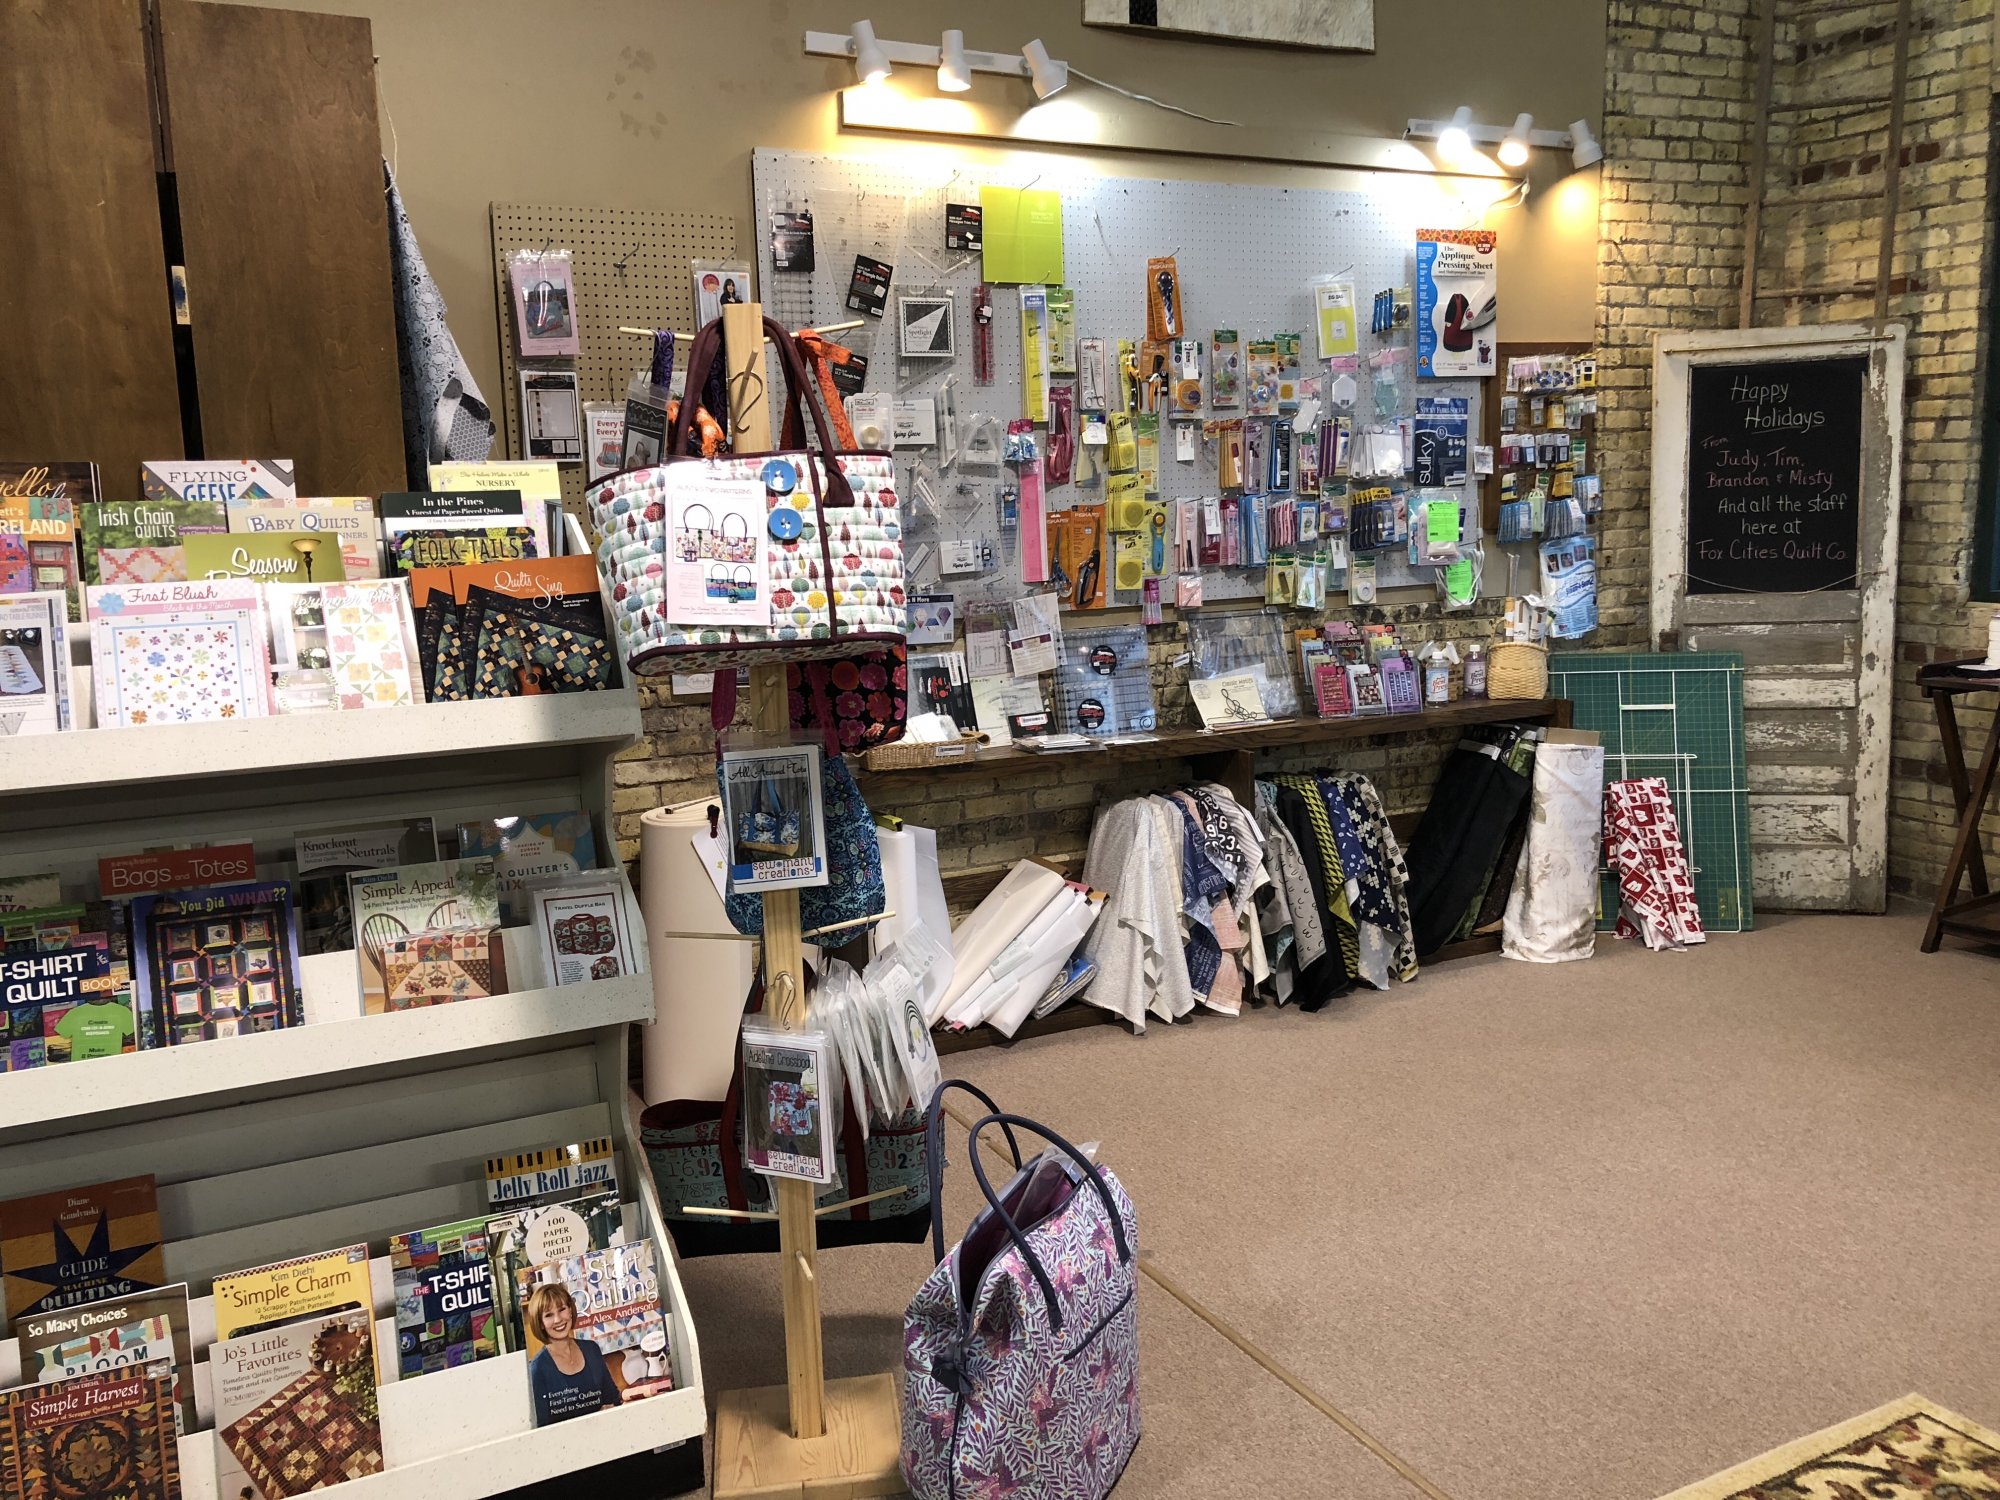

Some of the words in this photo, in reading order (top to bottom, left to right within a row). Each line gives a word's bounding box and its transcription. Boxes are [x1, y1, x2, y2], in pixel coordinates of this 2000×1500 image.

[1440, 252, 1475, 260] Applique
[1438, 261, 1470, 270] Pressing
[1473, 262, 1493, 270] Sheet
[1731, 375, 1789, 405] Happy
[1744, 406, 1825, 434] Holidays
[1700, 435, 1728, 449] From
[168, 471, 247, 483] FLYING
[1706, 472, 1769, 488] Brandon
[1790, 470, 1833, 493] Misty
[183, 483, 236, 501] GEESE
[423, 498, 434, 507] In
[456, 497, 484, 505] Pines
[1719, 498, 1746, 514] And
[1750, 498, 1770, 512] all
[1776, 495, 1801, 512] the
[1808, 494, 1848, 512] staff
[0, 507, 24, 516] ett's
[98, 507, 128, 527] Irish
[134, 507, 175, 525] Chain
[0, 519, 66, 535] RELAND
[135, 525, 176, 538] QUILTS
[250, 517, 295, 532] BABY
[302, 514, 359, 531] QUILTS
[1741, 518, 1778, 535] here
[1783, 519, 1802, 535] at
[418, 538, 520, 561] FOLK-TAILS
[1696, 539, 1722, 560] Fox
[1730, 539, 1778, 560] Cities
[1784, 540, 1822, 560] Quilt
[1826, 543, 1846, 560] Co
[231, 547, 298, 576] Season
[128, 588, 169, 603] First
[173, 586, 217, 600] Blush
[494, 571, 532, 592] Quilts
[533, 575, 566, 609] Sing
[209, 601, 234, 609] Month
[728, 765, 750, 781] All
[751, 763, 785, 778] Around
[303, 838, 358, 852] Knockout
[346, 844, 396, 859] Neutrals
[112, 868, 172, 888] Bags
[175, 873, 190, 881] and
[188, 859, 248, 878] Totes
[508, 863, 570, 878] QUILTER'S
[758, 867, 810, 880] creations
[362, 883, 406, 901] Simple
[410, 877, 455, 895] Appeal
[180, 901, 201, 915] You
[206, 897, 225, 911] Did
[230, 887, 286, 906] WHAT??
[0, 953, 87, 982] T-SHIRT
[6, 977, 78, 1004] QUILT
[82, 977, 121, 991] BOOK
[773, 1160, 816, 1176] creations
[494, 1176, 531, 1200] Jelly
[536, 1168, 570, 1192] Roll
[575, 1164, 609, 1184] Jazz
[67, 1198, 90, 1207] Diane
[547, 1217, 565, 1226] 100
[543, 1227, 569, 1238] PAPER
[543, 1236, 572, 1248] PIECED
[545, 1246, 571, 1258] QUILT
[59, 1256, 108, 1278] GUIDE
[271, 1272, 289, 1283] Kim
[292, 1266, 315, 1278] Diehl
[41, 1280, 132, 1311] QUILTING
[234, 1283, 290, 1308] Simple
[296, 1271, 351, 1294] Charm
[414, 1286, 429, 1296] THE
[442, 1285, 490, 1312] QUIL
[570, 1279, 658, 1317] Quilting
[263, 1302, 287, 1313] Scrappy
[290, 1294, 322, 1306] Patchwork
[290, 1304, 306, 1314] Quilt
[308, 1300, 333, 1310] Patterns
[28, 1324, 43, 1338] So
[46, 1318, 78, 1334] Many
[81, 1308, 128, 1327] Choices
[592, 1313, 613, 1325] Alex
[616, 1303, 653, 1318] Anderson
[222, 1346, 246, 1364] Jo's
[251, 1335, 289, 1355] Little
[237, 1349, 302, 1373] Favorites
[222, 1375, 250, 1385] Timeless
[252, 1369, 272, 1379] Quilts
[274, 1365, 290, 1373] from
[223, 1384, 245, 1393] Scraps
[246, 1380, 260, 1388] and
[274, 1369, 302, 1381] Quarters
[30, 1394, 78, 1418] Simple
[84, 1383, 139, 1405] Harvest
[548, 1387, 579, 1399] Everything
[578, 1390, 602, 1400] Quilters
[576, 1399, 600, 1409] Succeed
